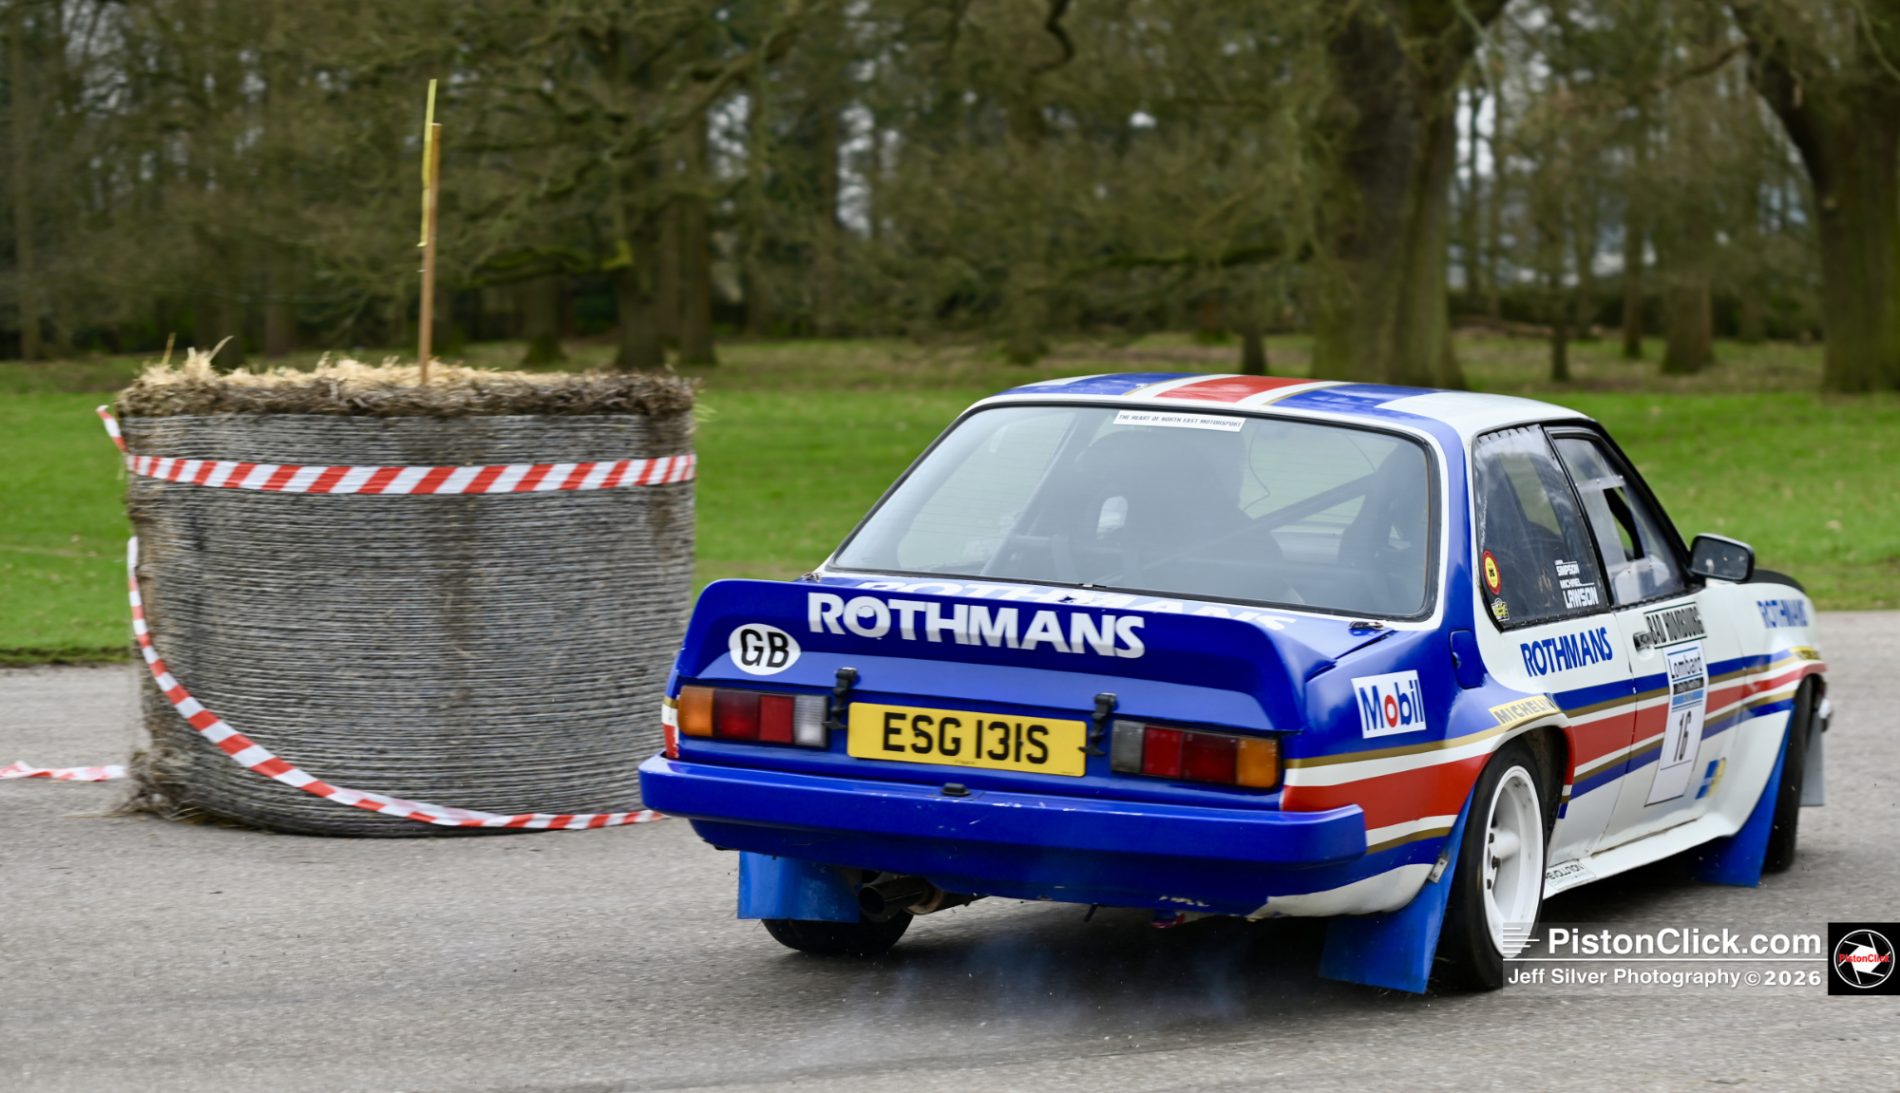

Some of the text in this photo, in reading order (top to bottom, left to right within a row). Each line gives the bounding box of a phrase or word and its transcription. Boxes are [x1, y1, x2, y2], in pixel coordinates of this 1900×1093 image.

[1563, 587, 1599, 609] LAWSON
[739, 628, 789, 668] GB
[807, 592, 1145, 658] ROTHMANS
[1520, 627, 1614, 677] ROTHMANS
[1359, 679, 1424, 731] Mobil
[882, 711, 1049, 765] ESG 131S
[1673, 711, 1692, 763] 16
